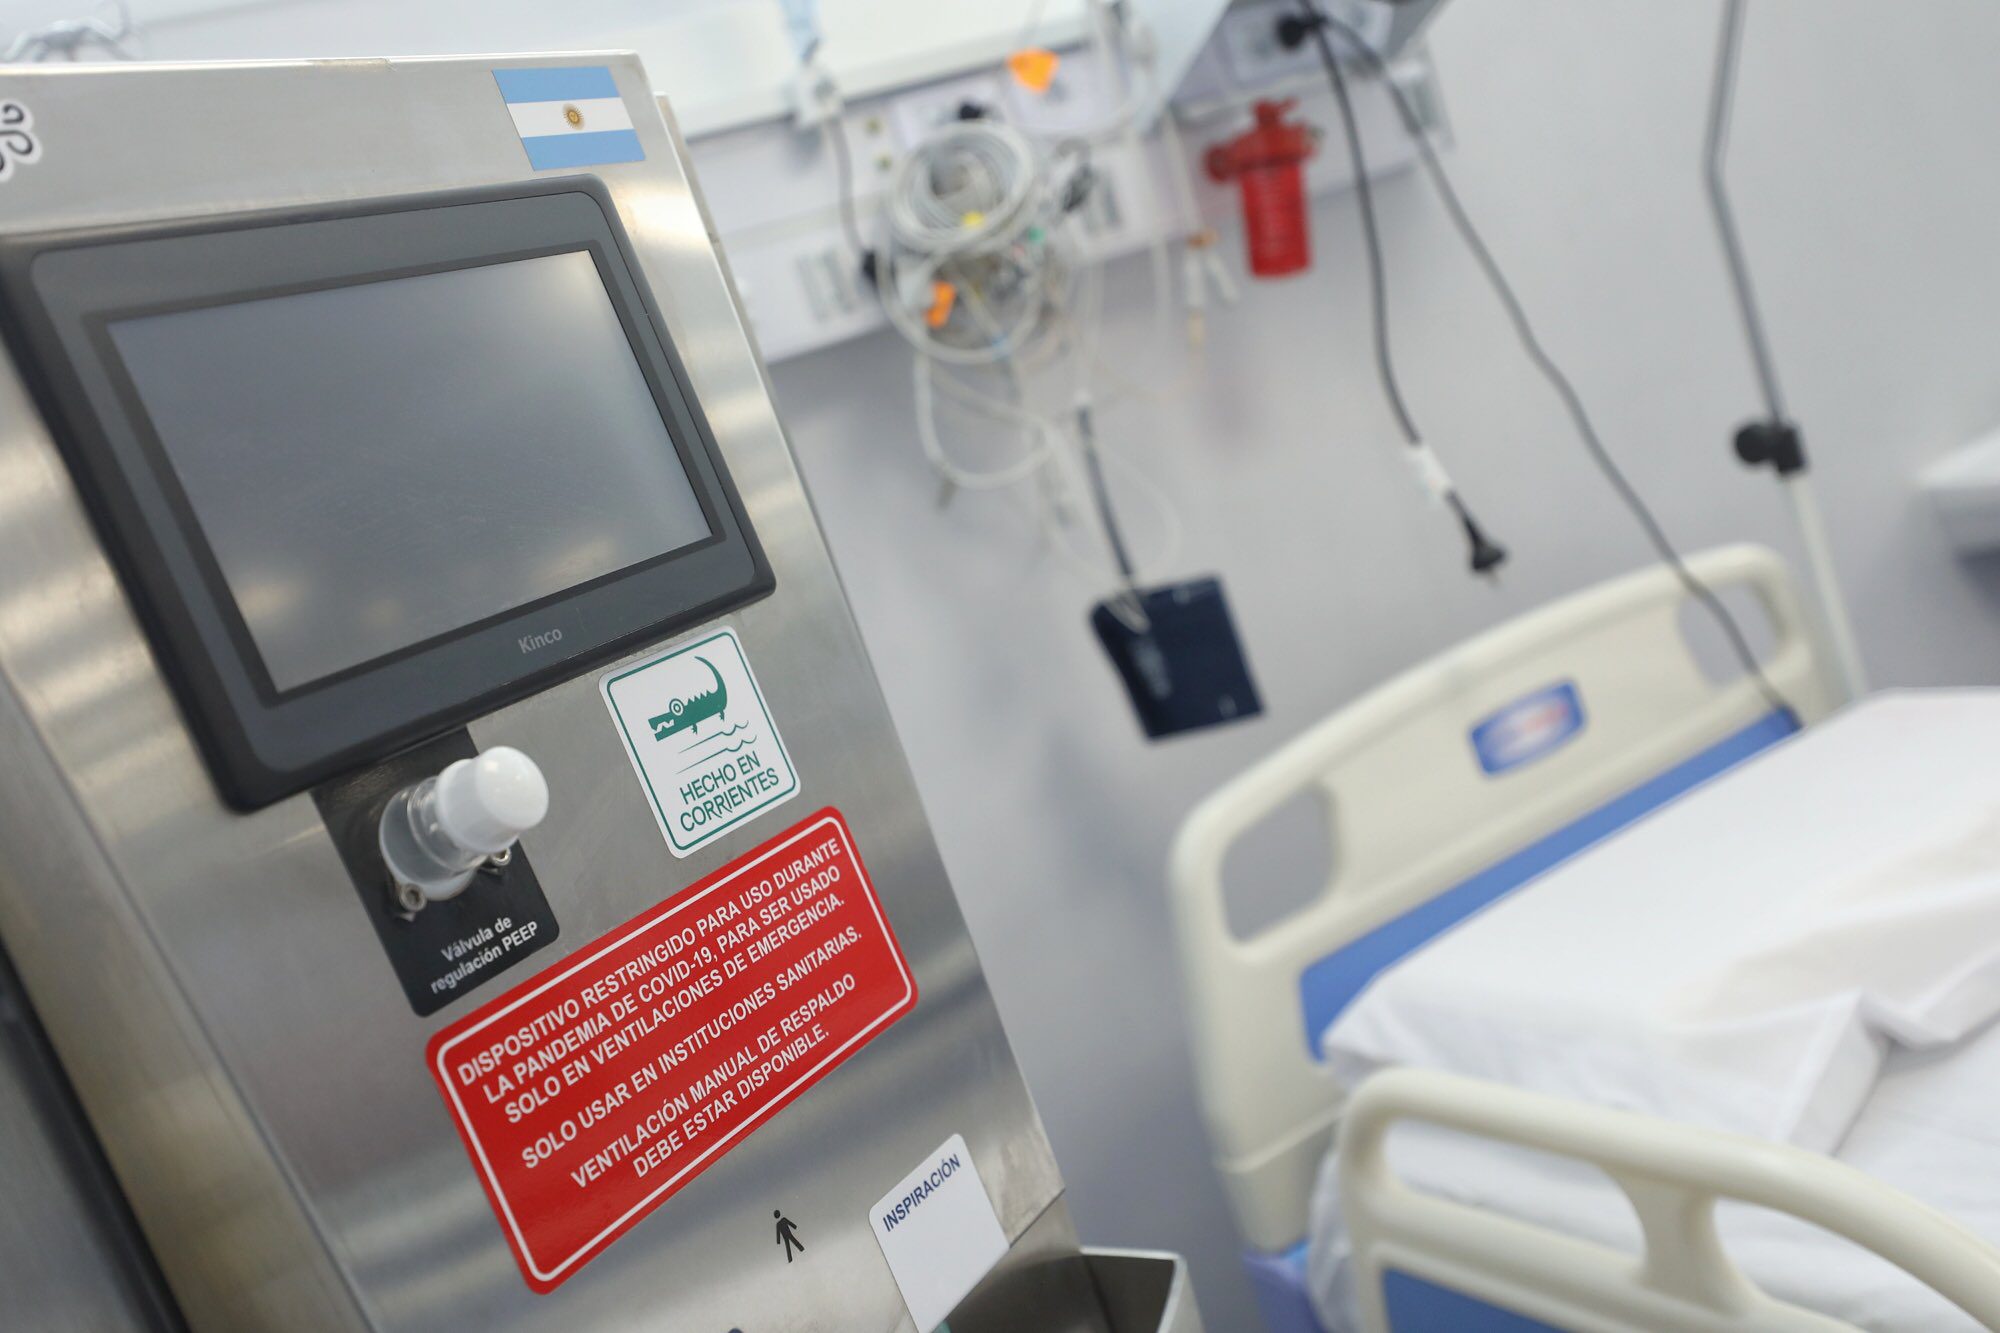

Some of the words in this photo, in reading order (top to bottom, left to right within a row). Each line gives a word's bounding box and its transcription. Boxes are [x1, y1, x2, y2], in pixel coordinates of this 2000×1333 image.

[518, 629, 562, 654] Kinco
[679, 763, 737, 805] HECHO
[736, 750, 761, 775] EN
[680, 767, 779, 832] CORRIENTES
[430, 945, 503, 994] regulación
[501, 921, 538, 952] PEEP
[441, 927, 494, 962] Válvula
[494, 917, 513, 934] de
[457, 998, 580, 1086] DISPOSITIVO
[580, 927, 696, 1009] RESTRINGIDO
[696, 901, 742, 937] PARA
[739, 880, 773, 910] USO
[772, 838, 841, 889] DURANTE
[482, 1074, 515, 1104] LA
[512, 1012, 612, 1085] PANDEMIA
[609, 993, 639, 1022] DE
[638, 946, 718, 1003] COVID-19,
[716, 917, 761, 953] PARA
[759, 896, 792, 926] SER
[790, 865, 841, 906] USADO
[504, 1075, 561, 1124] SOLO
[561, 1055, 592, 1086] EN
[590, 969, 723, 1065] VENTILACIONES
[722, 952, 748, 979] DE
[746, 893, 845, 964] EMERGENCIA.
[521, 1120, 577, 1169] SOLO
[578, 1082, 633, 1129] USAR
[630, 1063, 658, 1093] EN
[657, 982, 776, 1074] INSTITUCIONES
[775, 925, 862, 991] SANITARIAS.
[570, 1093, 690, 1188] VENTILACIÓN
[688, 1046, 759, 1104] MANUAL
[756, 1027, 782, 1054] DE
[779, 973, 856, 1037] RESPALDO
[632, 1130, 684, 1178] DEBE
[682, 1090, 738, 1141] ESTAR
[736, 1023, 830, 1100] DISPONIBLE.
[882, 1153, 961, 1232] INSPIRACIÓN
